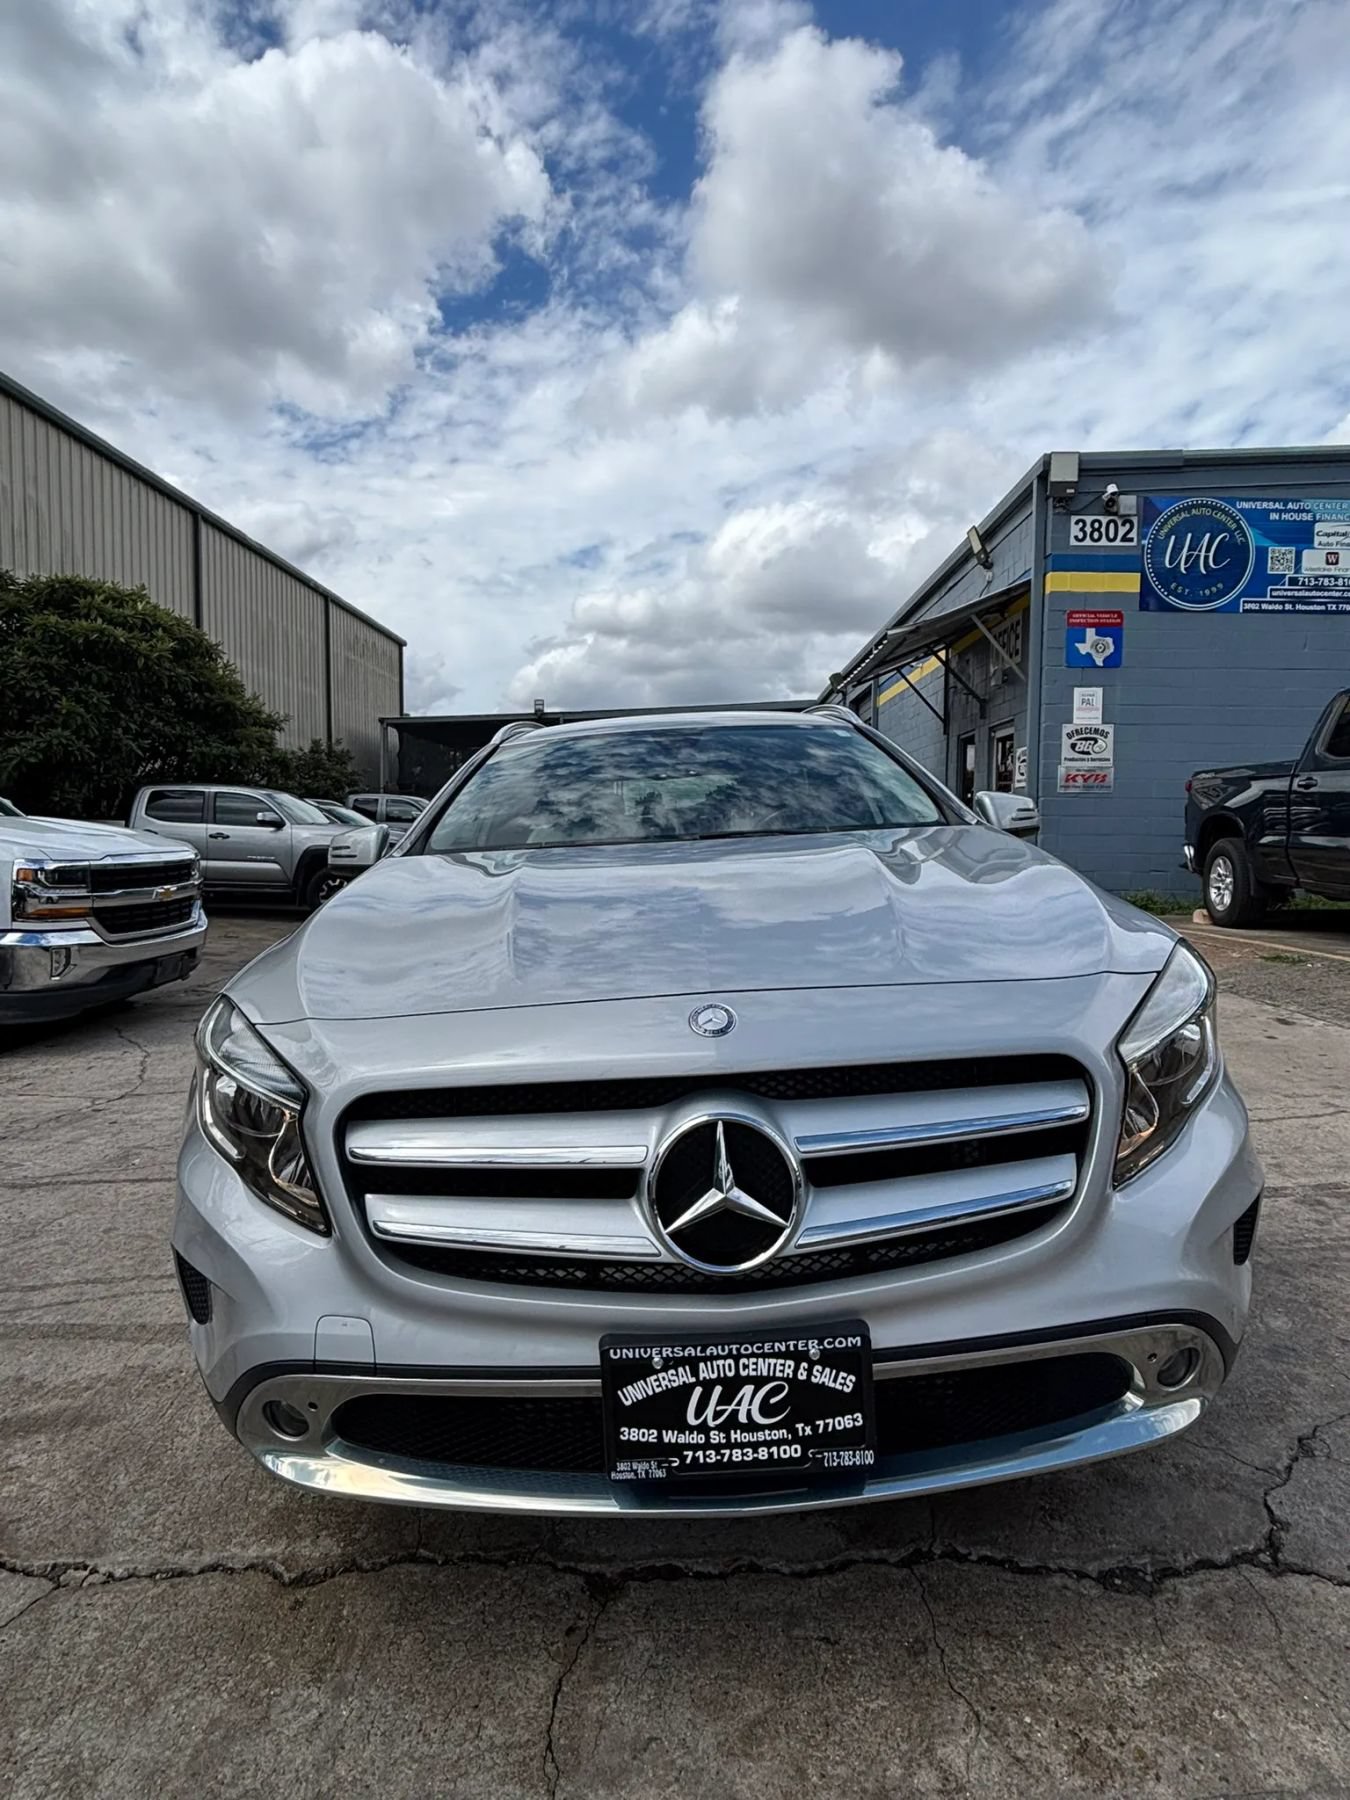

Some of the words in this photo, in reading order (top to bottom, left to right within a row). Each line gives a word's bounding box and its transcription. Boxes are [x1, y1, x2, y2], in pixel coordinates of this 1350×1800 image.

[1236, 501, 1285, 510] UNIVERSAL
[1286, 501, 1312, 510] AUTO
[1313, 502, 1348, 510] CENTER
[1157, 510, 1191, 540] UNIVERSAL
[1191, 507, 1212, 516] AUTO
[1212, 509, 1237, 531] CENTER
[1269, 512, 1280, 521] IN
[1281, 512, 1314, 521] HOUSE
[1073, 518, 1135, 543] 3802
[1164, 532, 1231, 575] UAC
[1327, 553, 1339, 565] W
[1065, 727, 1110, 740] OFRECEMOS
[609, 1336, 862, 1359] UNIVERSALAUTOCENTER.COM
[617, 1365, 696, 1406] UNIVERSAL
[699, 1359, 735, 1381] AUTO
[739, 1358, 795, 1378] CENTER
[797, 1362, 808, 1380] &
[811, 1365, 856, 1393] SALES
[686, 1381, 791, 1427] UAC
[620, 1427, 658, 1442] 3802
[662, 1430, 705, 1444] Waldo
[709, 1430, 726, 1444] St
[730, 1428, 792, 1443] Houston,
[795, 1423, 812, 1436] Tx
[816, 1413, 863, 1434] 77063
[683, 1444, 801, 1464] 713-783-8100
[823, 1450, 874, 1467] 713-783-8100
[616, 1461, 631, 1471] 3802
[637, 1469, 646, 1479] TX
